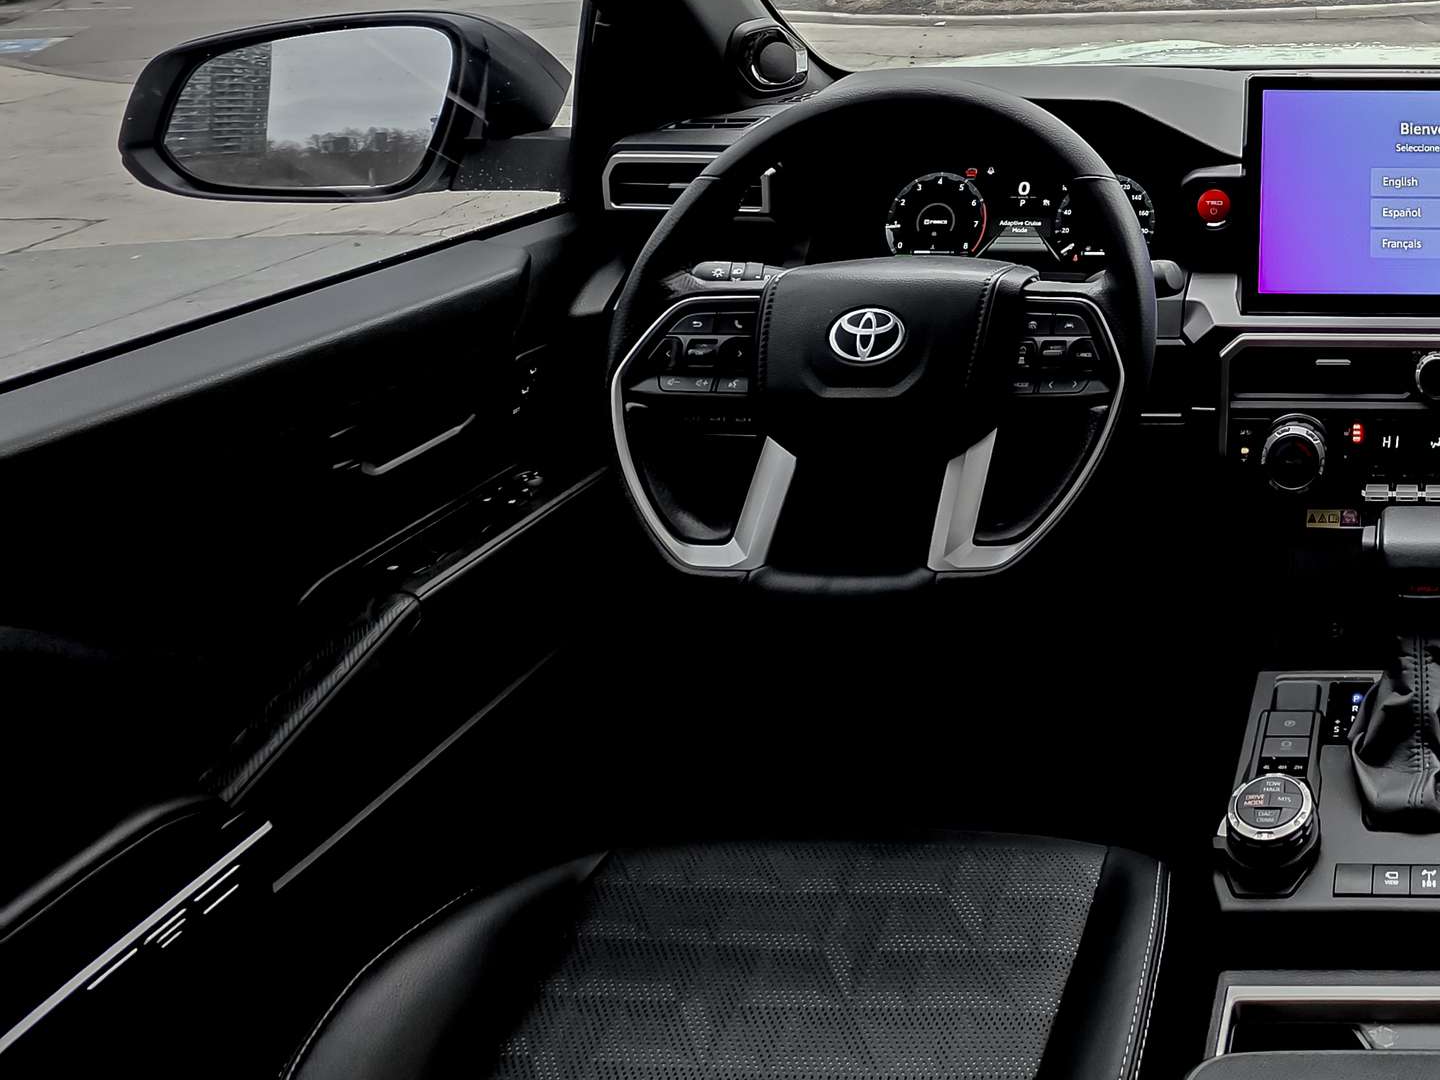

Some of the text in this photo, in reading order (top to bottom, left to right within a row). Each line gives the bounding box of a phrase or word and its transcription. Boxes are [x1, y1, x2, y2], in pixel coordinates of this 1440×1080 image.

[1395, 143, 1440, 153] Seleccione
[1383, 176, 1418, 189] English
[1018, 181, 1030, 196] 0
[971, 199, 977, 207] 6
[1019, 199, 1026, 207] P
[1382, 207, 1422, 219] Español
[973, 220, 979, 228] 7
[897, 241, 903, 249] 0
[1382, 238, 1422, 250] Français
[1333, 725, 1340, 733] S
